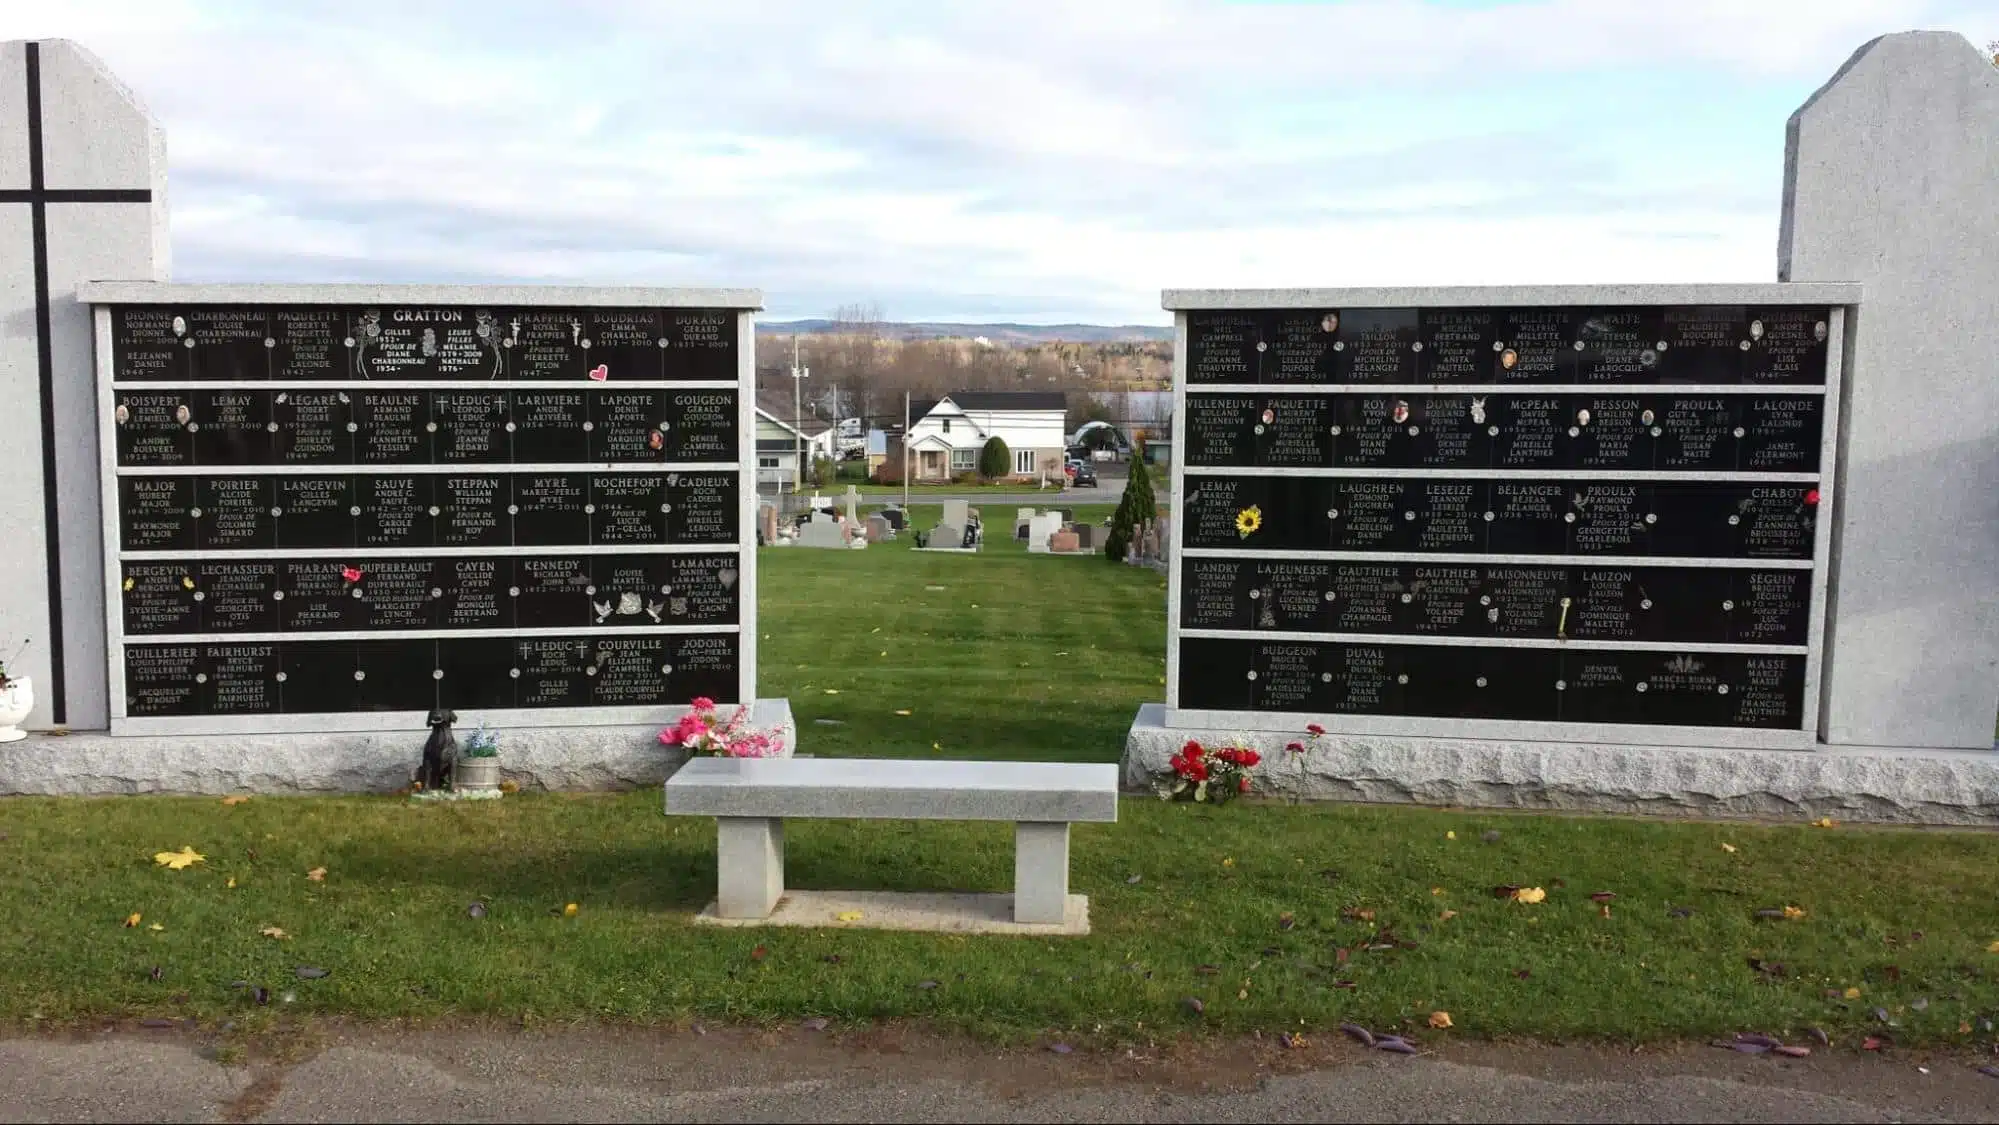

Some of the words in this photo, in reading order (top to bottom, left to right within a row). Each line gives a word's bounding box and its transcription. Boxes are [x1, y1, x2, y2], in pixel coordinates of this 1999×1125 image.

[191, 312, 266, 321] CHARBONNEAU
[277, 313, 340, 321] PAQUETTE
[393, 311, 462, 321] GRATTON
[123, 396, 181, 405] BOISVERT
[212, 396, 251, 406] LEMAY
[365, 396, 419, 405] BEAULNE
[452, 396, 490, 405] LEDUC
[600, 396, 652, 405] LAPORTE
[675, 396, 732, 405] GOUGEON
[1186, 400, 1255, 408] VILLENEUVE
[1267, 400, 1327, 409] PAQUETTE
[1363, 400, 1386, 409] ROY
[1425, 400, 1465, 409] DUVAL
[1593, 400, 1639, 410] BESSON
[1674, 400, 1724, 410] PROULX
[1754, 401, 1813, 410] LALONDE
[134, 482, 176, 491] MAJOR
[211, 481, 259, 490] POIRIER
[283, 481, 346, 490] LANGEVIN
[448, 479, 498, 489] STEPPAN
[535, 479, 567, 488] MYRE
[594, 478, 662, 487] ROCHEFORT
[679, 478, 729, 487] CADIEUX
[1200, 482, 1238, 491] LEMAY
[1340, 484, 1404, 493] LAUGHREN
[1426, 485, 1473, 495] LESEIZE
[1587, 487, 1636, 496] PROULX
[1752, 488, 1804, 498] CHABOT
[455, 562, 495, 571] CAYEN
[524, 561, 580, 570] KENNEDY
[672, 559, 734, 568] LAMARCHE
[128, 566, 188, 576] BERGEVIN
[201, 565, 275, 574] LECHASSEUR
[1194, 564, 1240, 573] LANDRY
[1257, 565, 1328, 574] LAJEUNESSE
[1338, 567, 1399, 576] GAUTHIER
[1415, 568, 1477, 578] GAUTHIER
[1487, 570, 1565, 580] MAISONNEUVE
[1583, 572, 1631, 582] LAUZON
[1341, 614, 1392, 622] CHAMPAGNE
[535, 642, 572, 651] LEDUC
[598, 640, 661, 650] COURVILLE
[682, 639, 726, 648] JODOIN
[127, 648, 198, 658] CUILLERIER
[207, 647, 272, 657] FAIRHURST
[1262, 647, 1317, 656] BUDGEON
[1346, 649, 1384, 658] DUVAL
